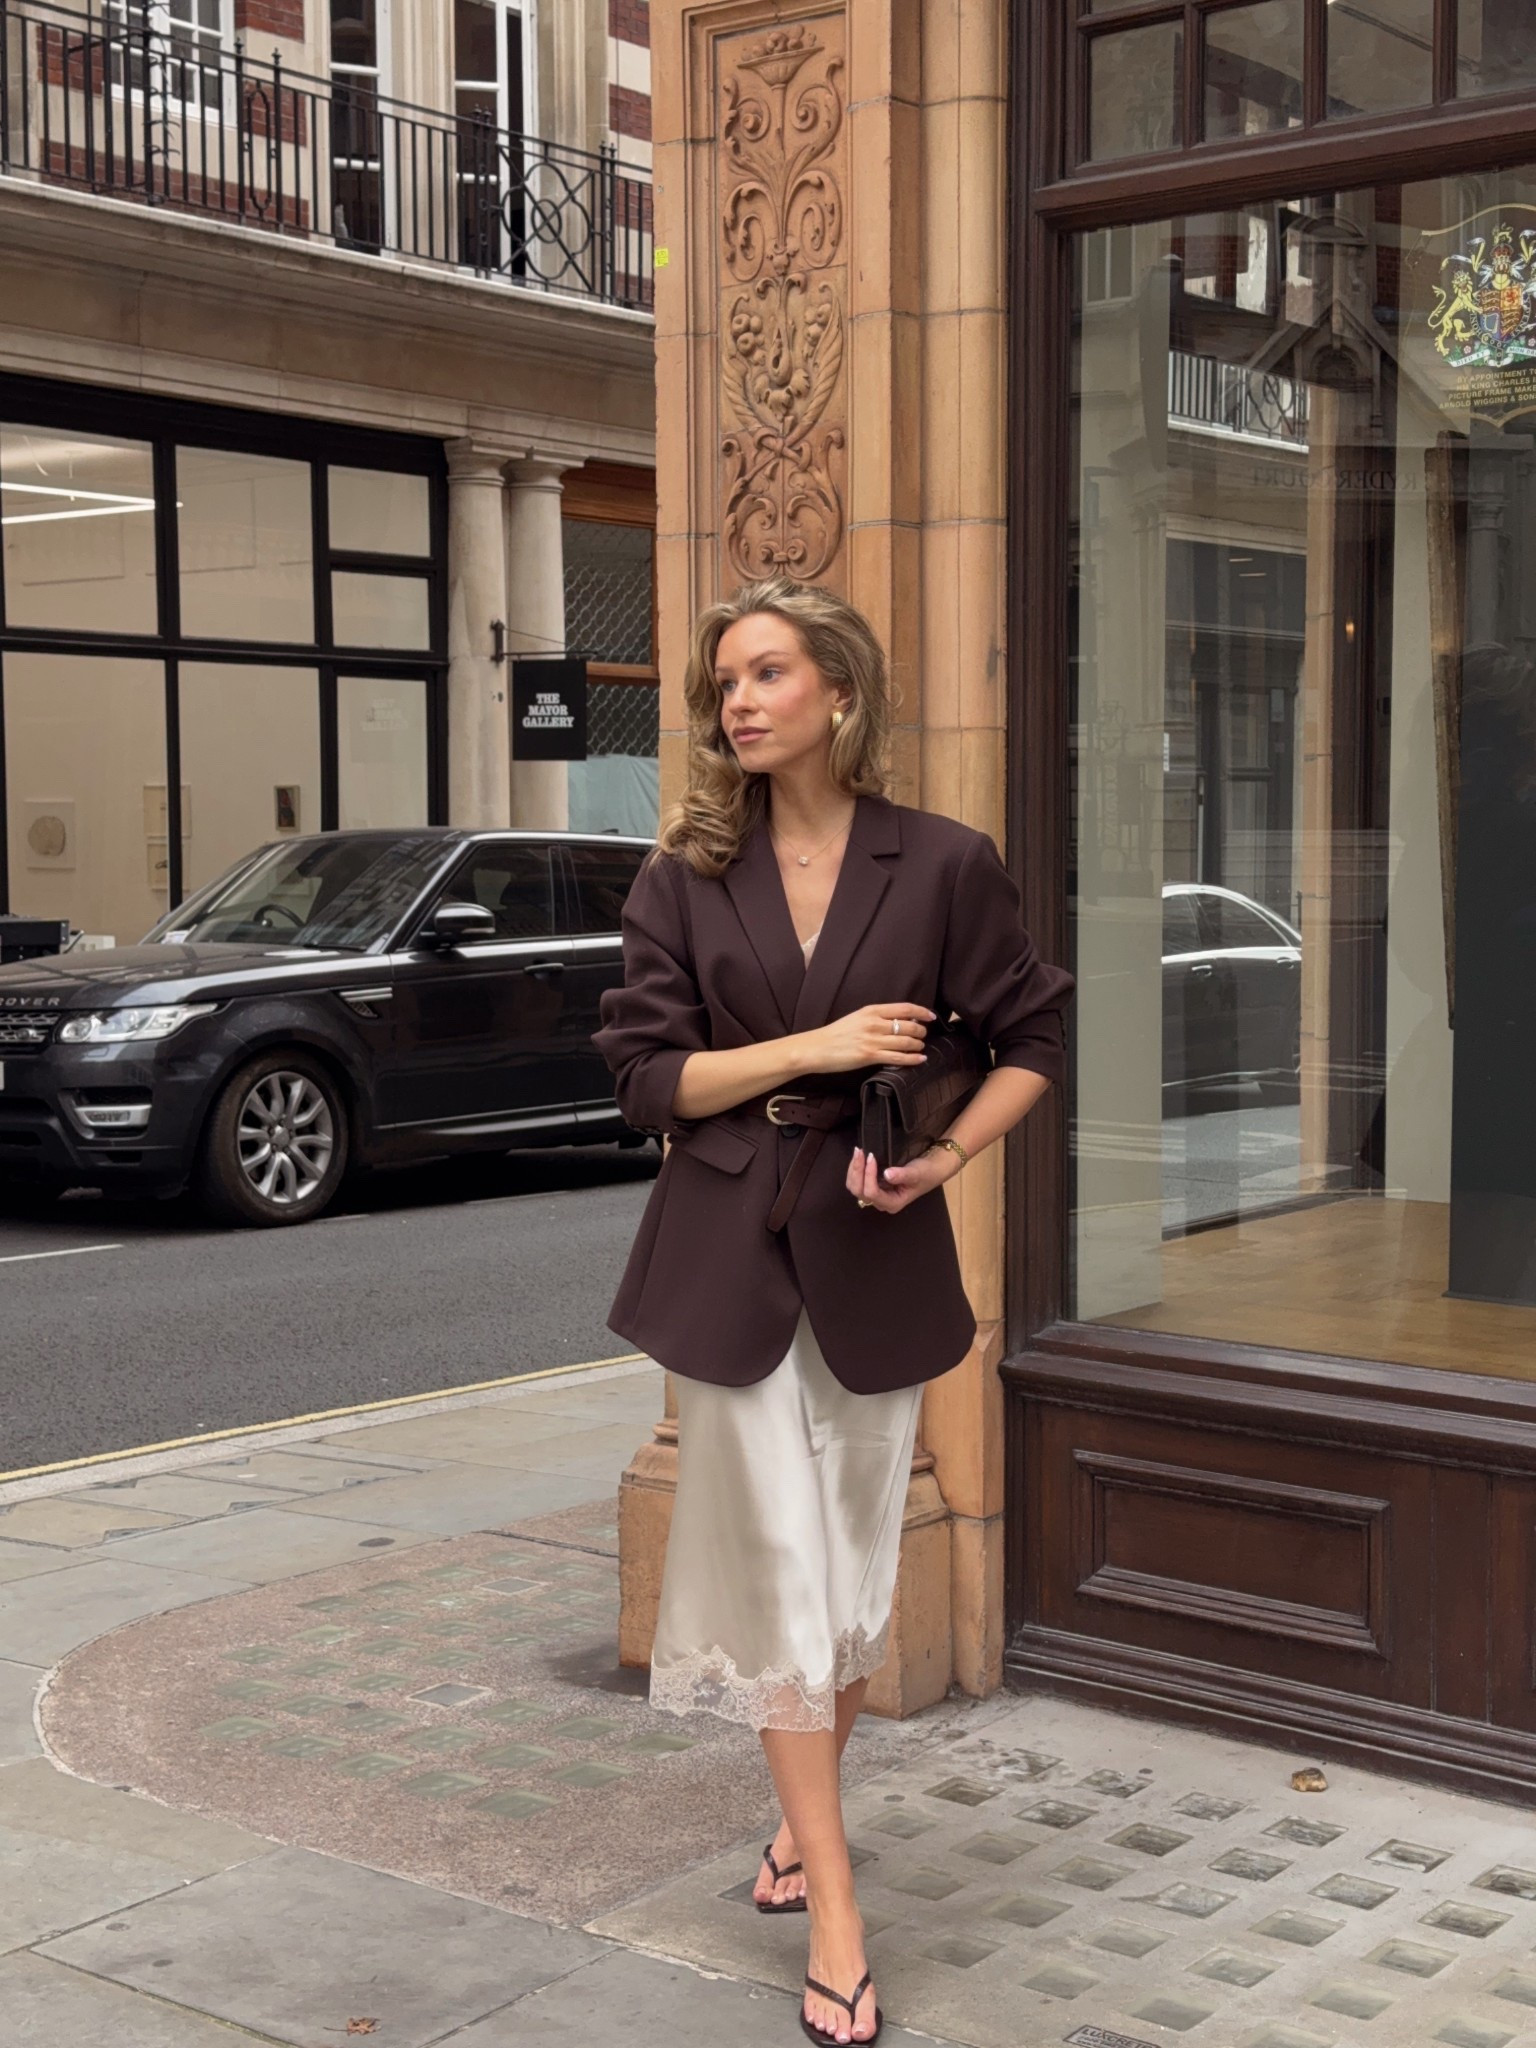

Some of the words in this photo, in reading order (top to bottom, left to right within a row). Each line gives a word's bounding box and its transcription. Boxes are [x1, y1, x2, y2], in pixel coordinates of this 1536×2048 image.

[1469, 369, 1527, 382] APPOINTMENT
[1471, 381, 1491, 389] KING
[1493, 377, 1530, 387] CHARLES
[1448, 390, 1482, 401] PICTURE
[1485, 387, 1511, 396] FRAME
[1439, 400, 1471, 409] ARNOLD
[1473, 396, 1508, 406] WIGGINS
[536, 692, 560, 704] THE
[528, 705, 568, 716] MAYOR
[522, 716, 575, 728] GALLERY
